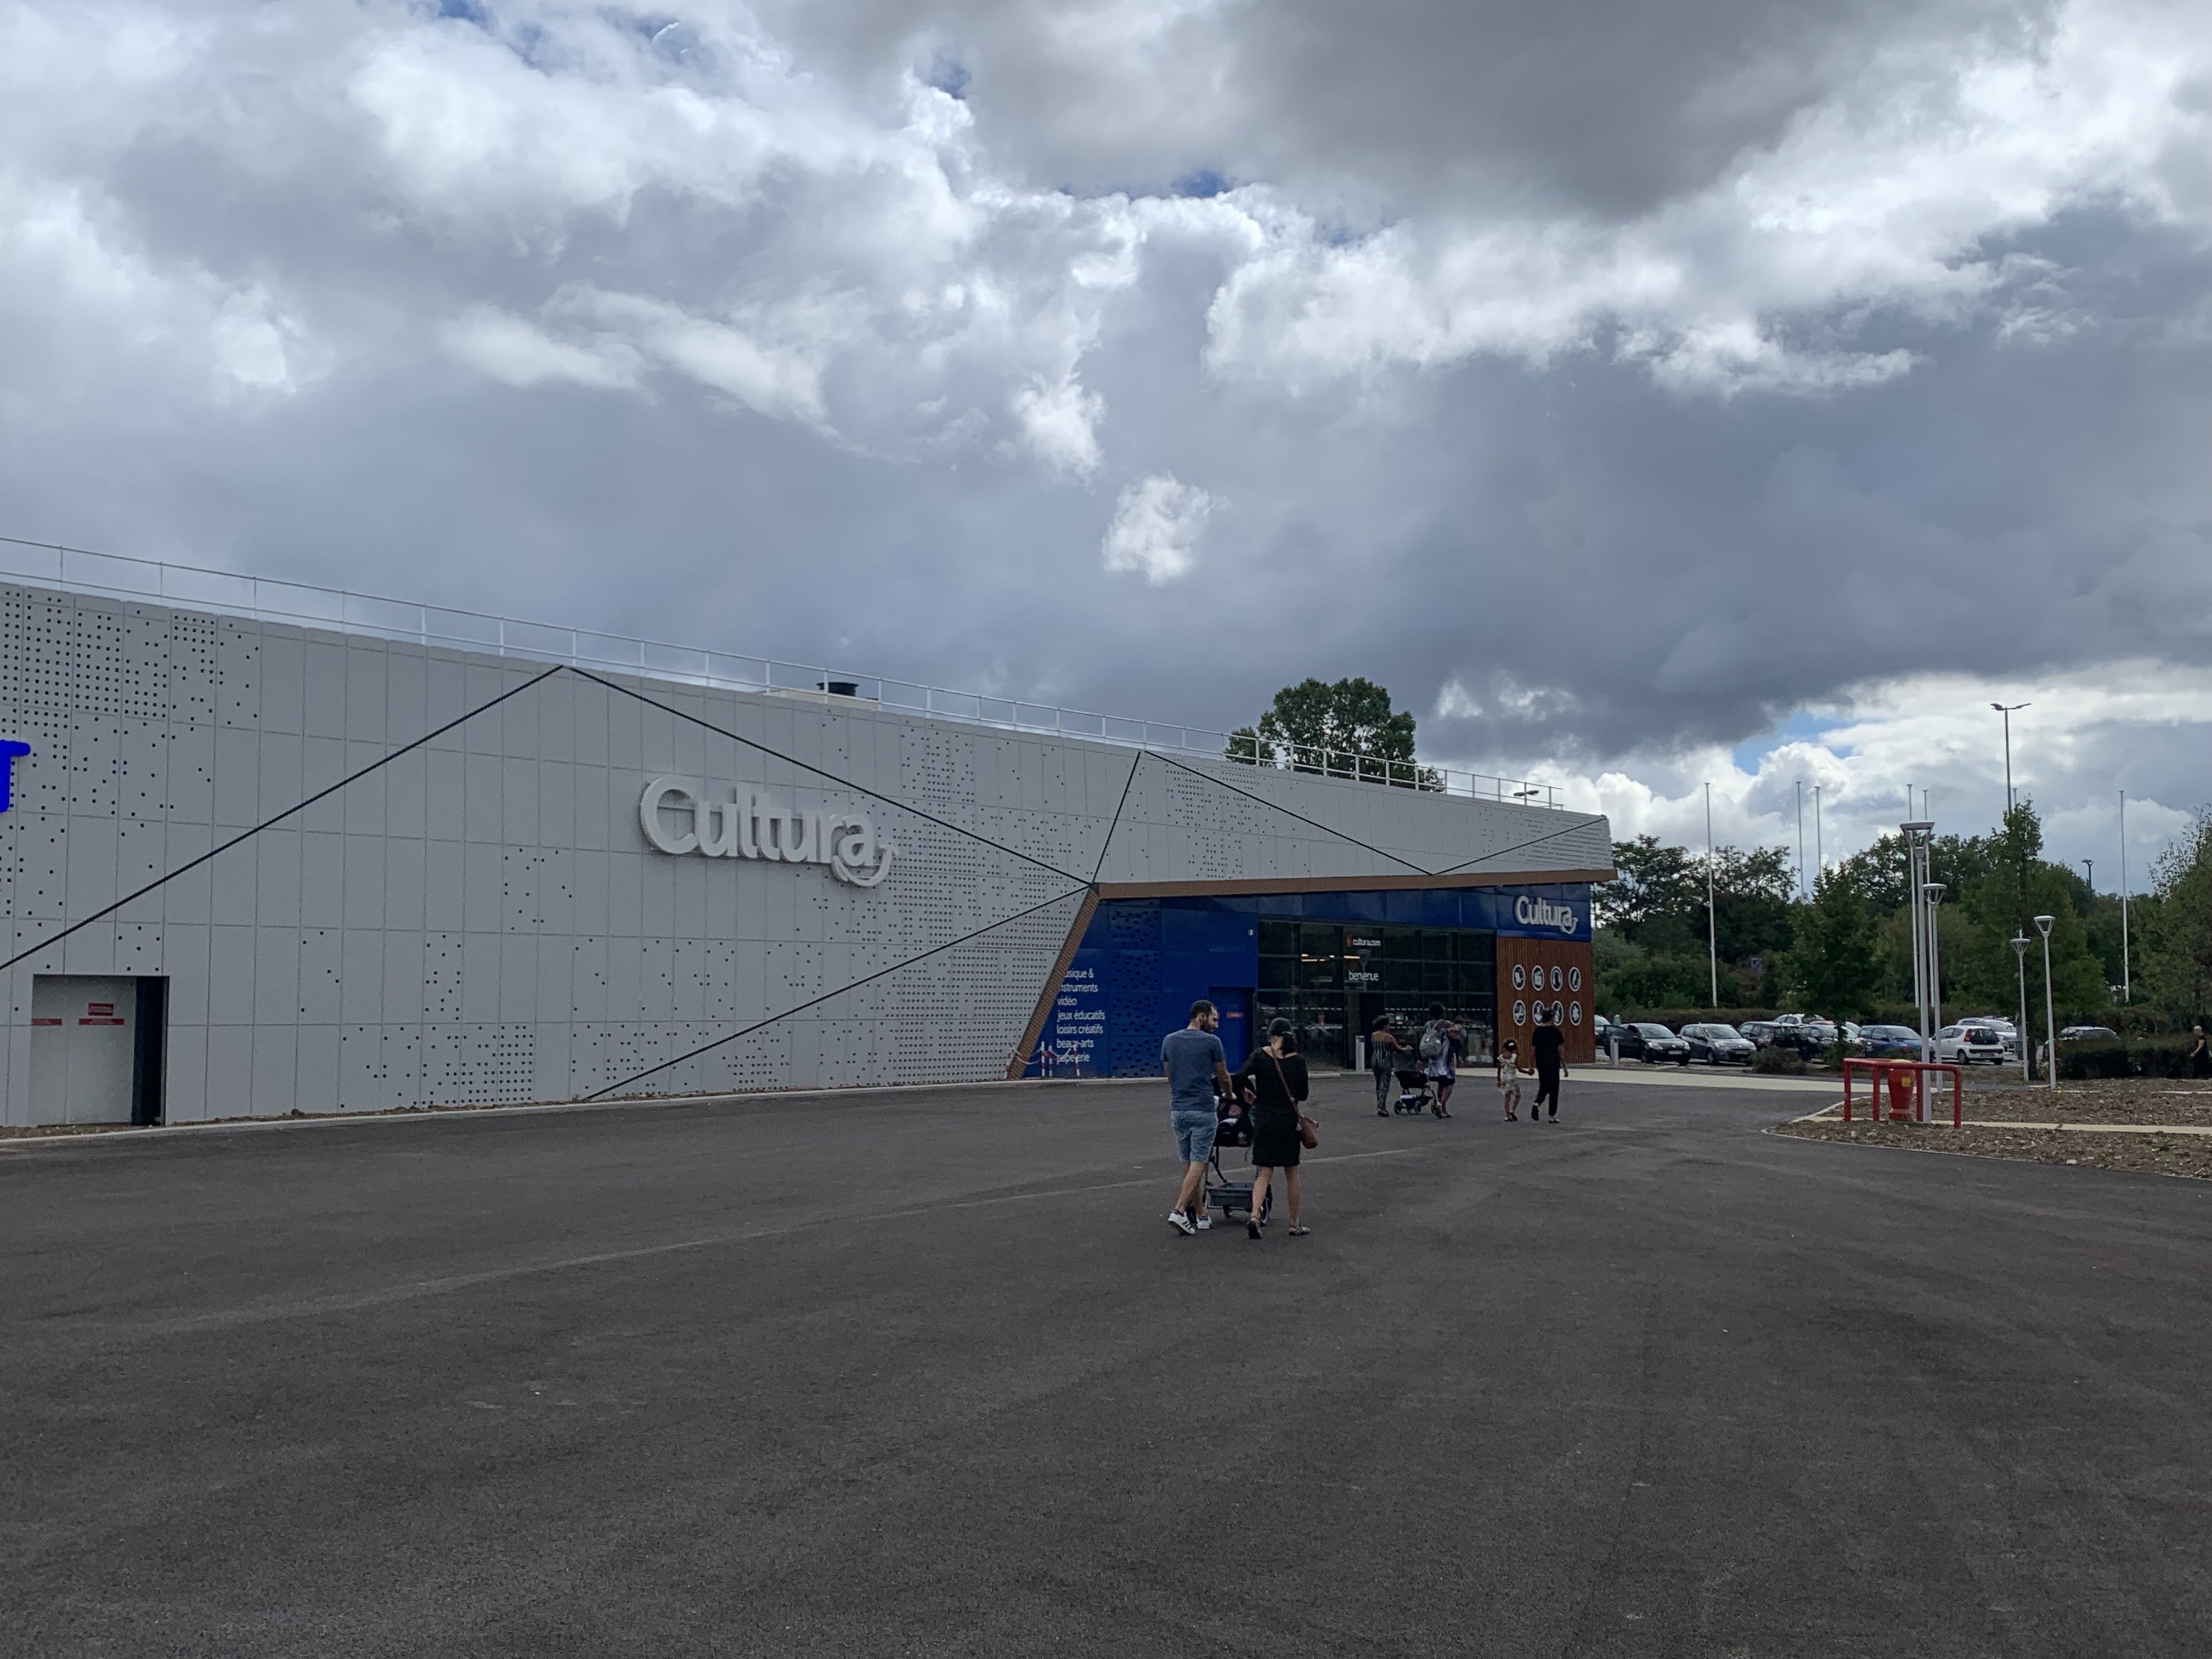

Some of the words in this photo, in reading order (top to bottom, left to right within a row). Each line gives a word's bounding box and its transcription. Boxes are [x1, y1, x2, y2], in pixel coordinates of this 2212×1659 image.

[640, 775, 899, 887] Cultura
[1515, 895, 1579, 934] Cultura
[1064, 968, 1087, 980] usique
[1088, 967, 1094, 978] &
[1348, 969, 1379, 981] bienvenue
[1057, 995, 1077, 1006] vidéo
[1057, 1009, 1073, 1023] jeux
[1074, 1009, 1106, 1020] éducatifs
[1056, 1024, 1077, 1034] loisirs
[1078, 1024, 1103, 1034] créatifs
